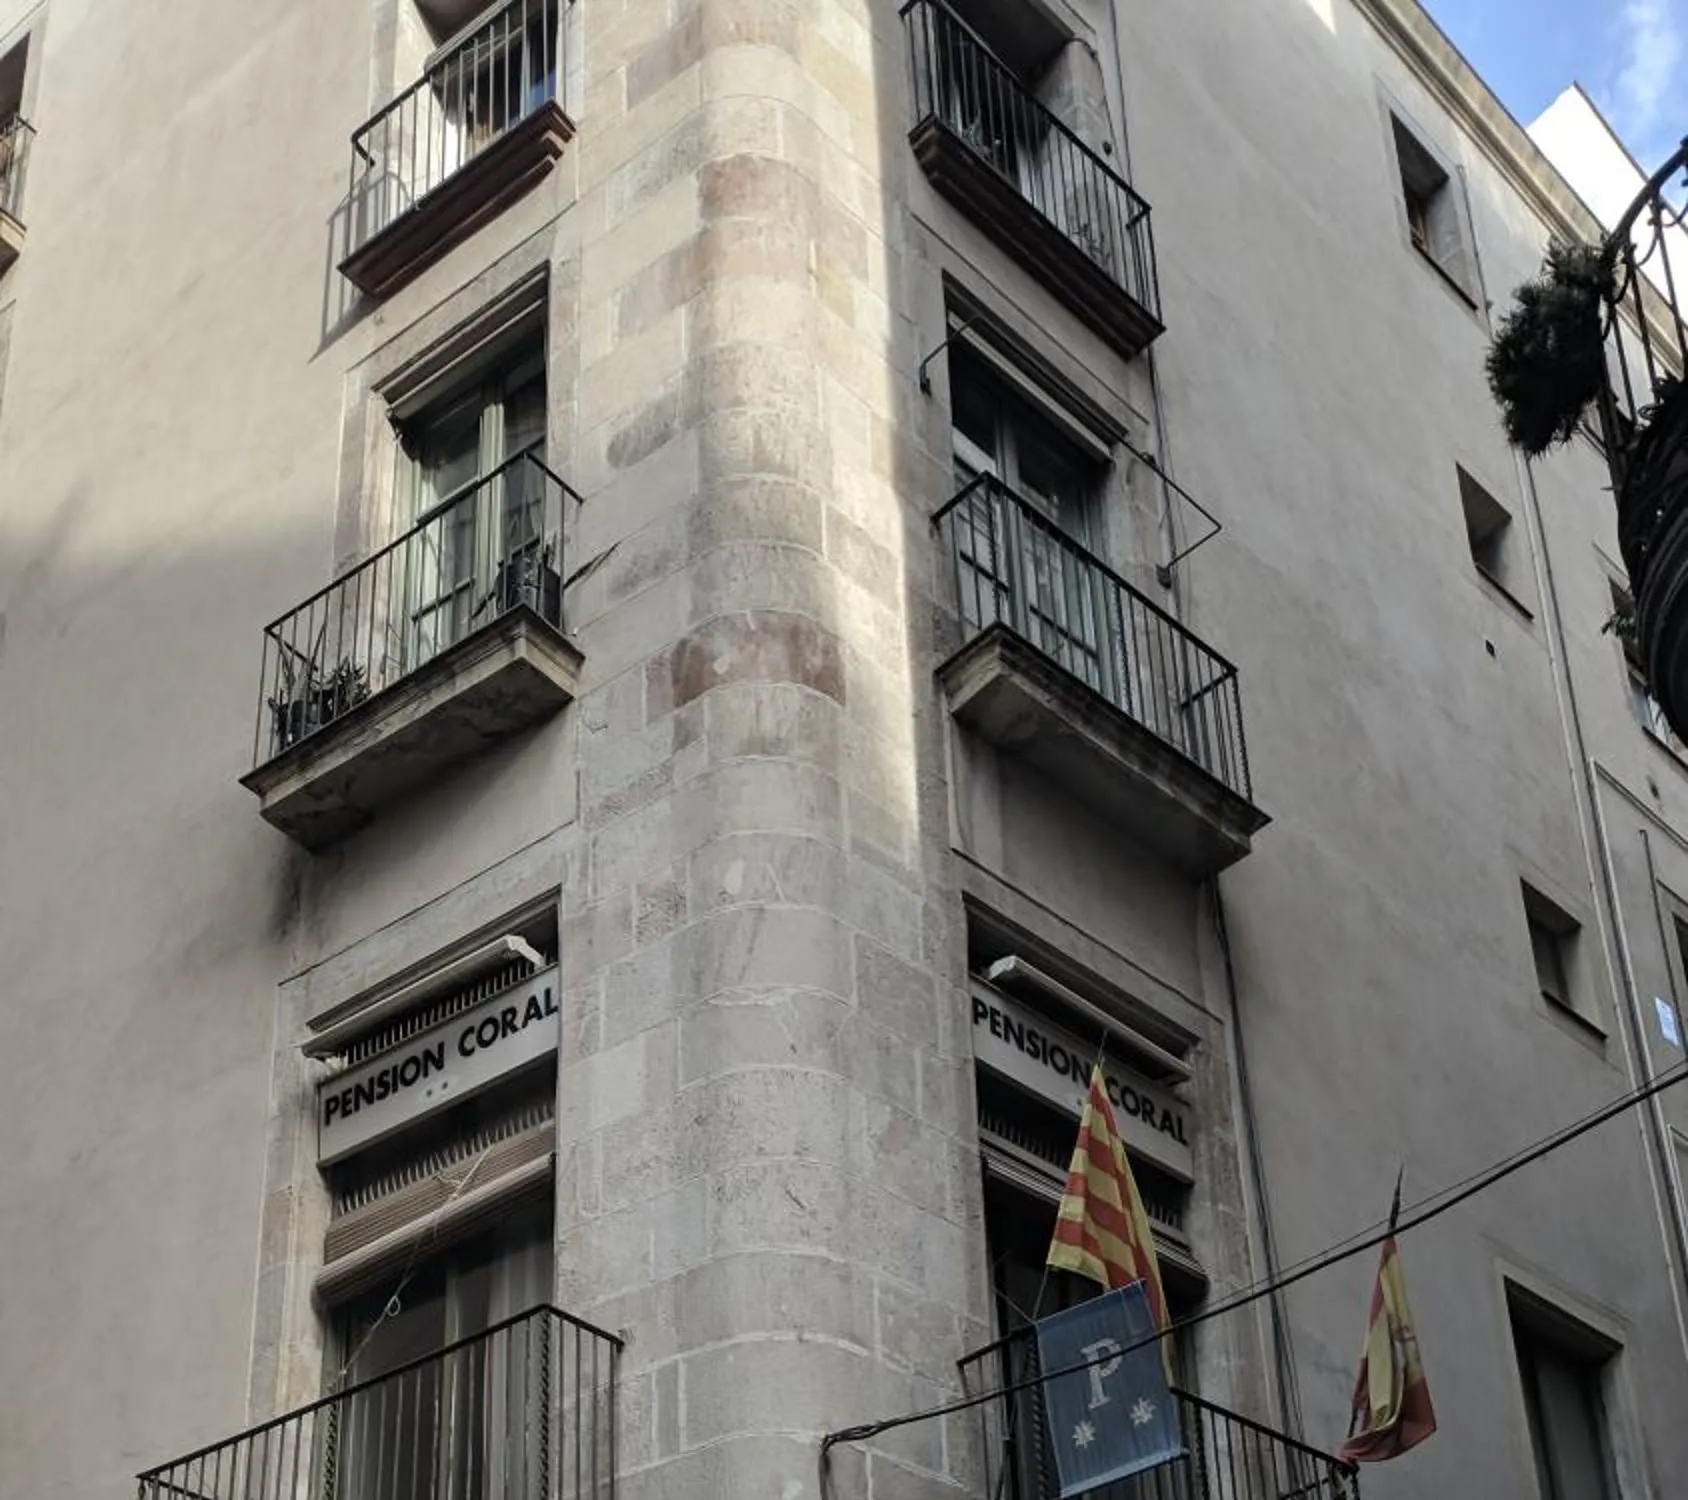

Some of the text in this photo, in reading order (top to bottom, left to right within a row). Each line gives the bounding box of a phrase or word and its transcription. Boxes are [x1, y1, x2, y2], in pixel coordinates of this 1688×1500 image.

[323, 986, 559, 1127] PENSION CORAL
[971, 996, 1188, 1147] PENSION CORAL
[1081, 1337, 1123, 1410] P
